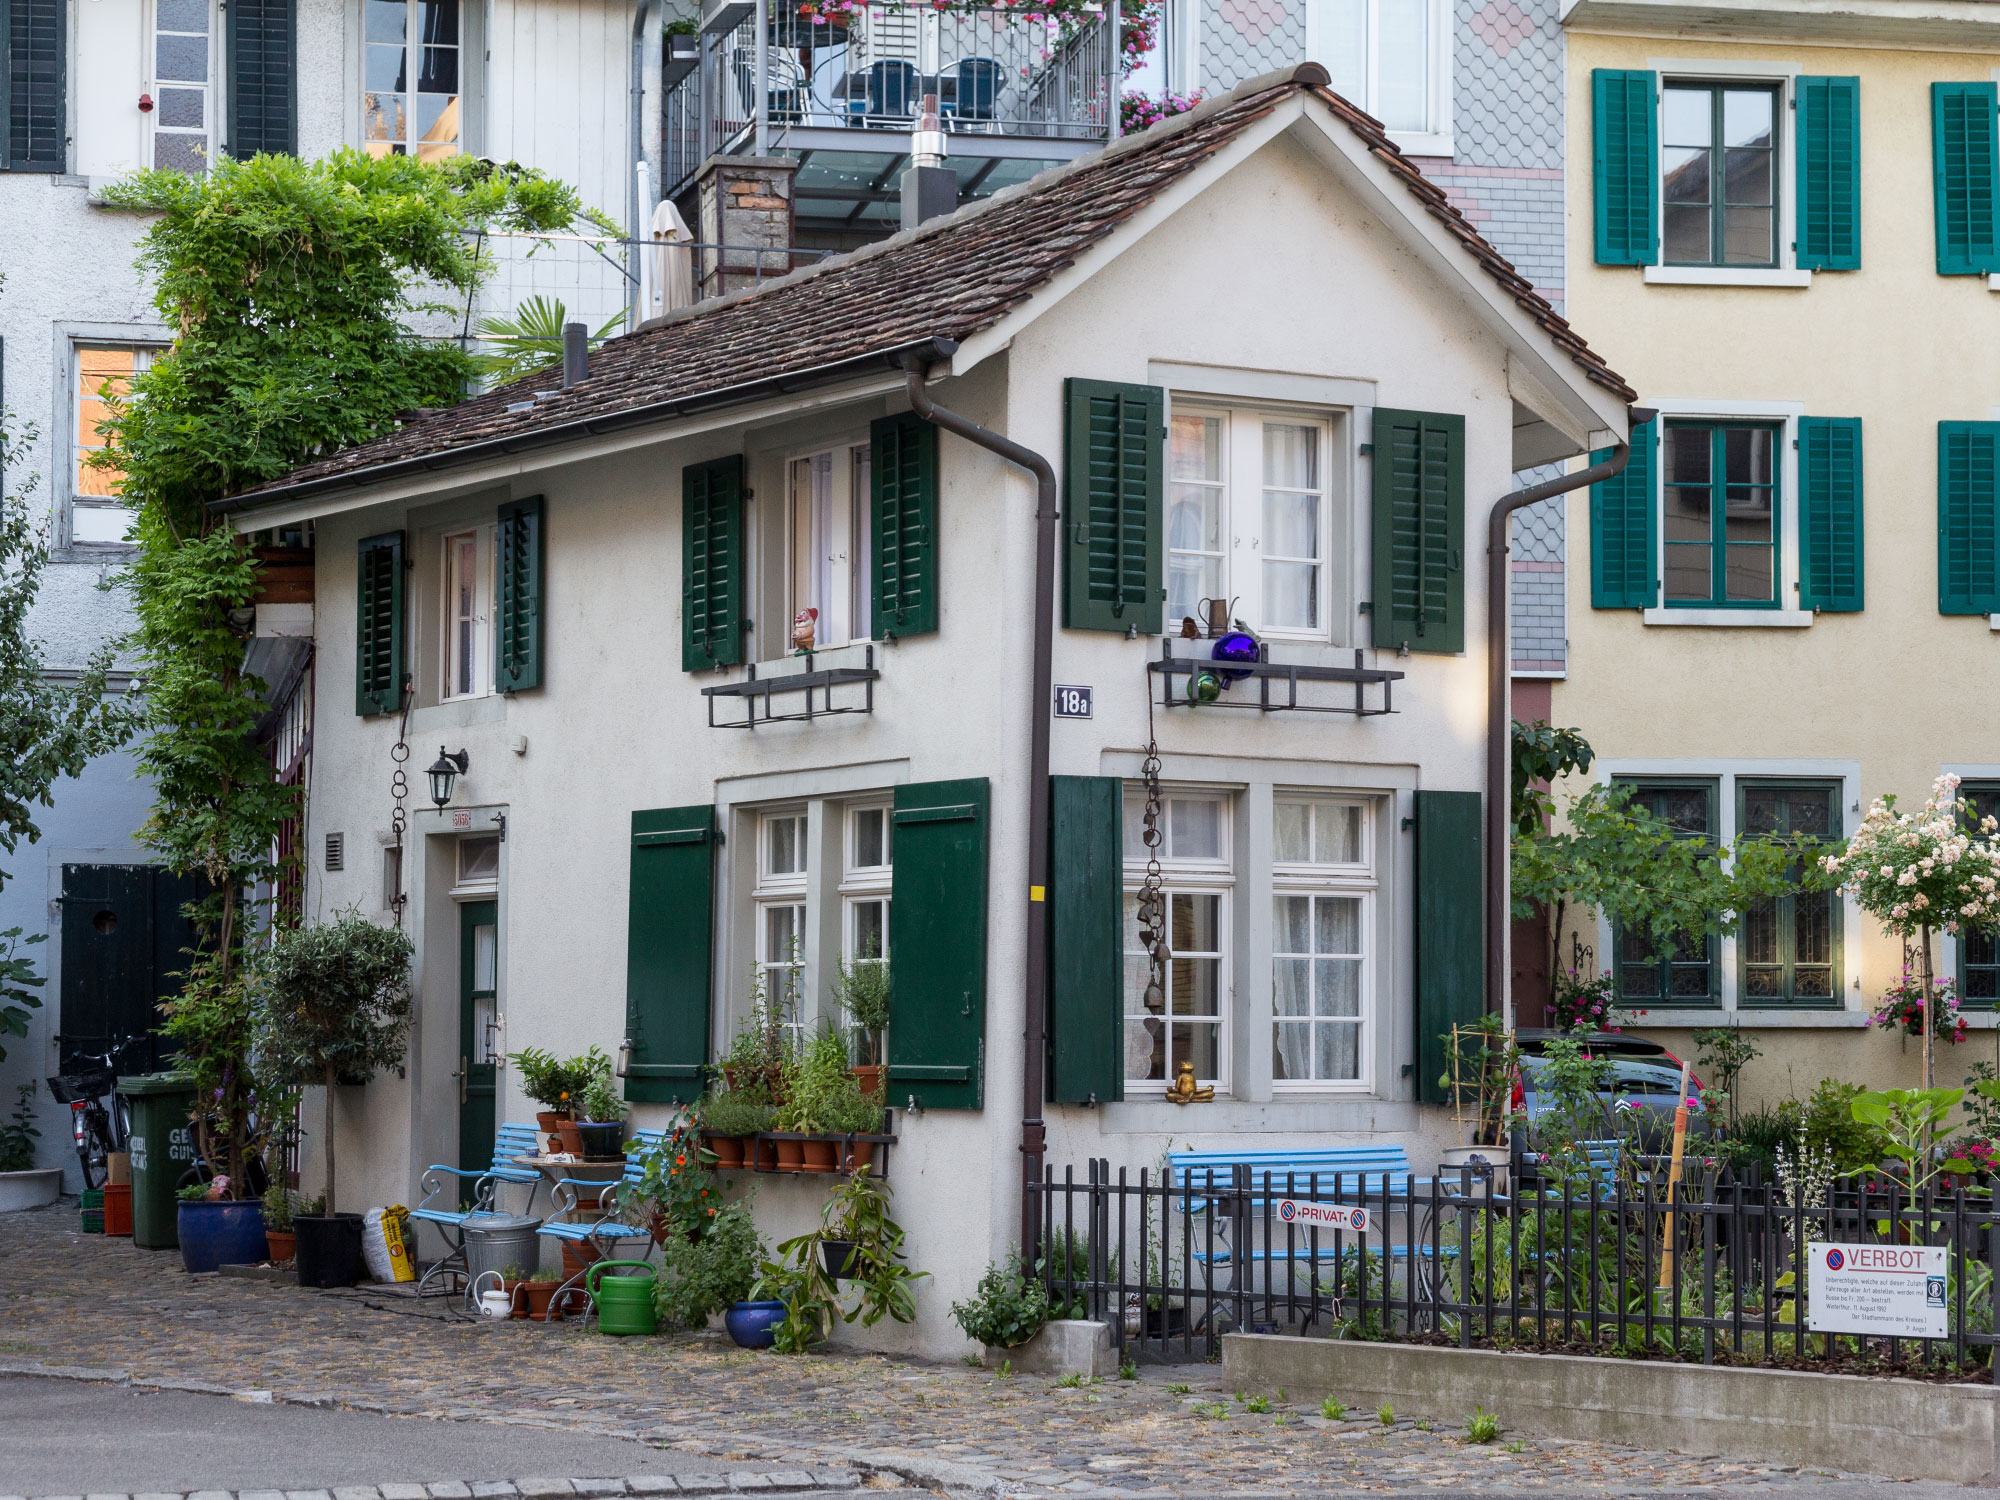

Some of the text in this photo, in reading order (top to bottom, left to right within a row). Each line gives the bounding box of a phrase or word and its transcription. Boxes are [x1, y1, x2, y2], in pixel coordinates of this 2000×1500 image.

[1061, 690, 1087, 713] 18a
[1302, 1207, 1344, 1222] PRIVAT
[1848, 1249, 1925, 1268] VERBOT
[1859, 1305, 1876, 1313] August
